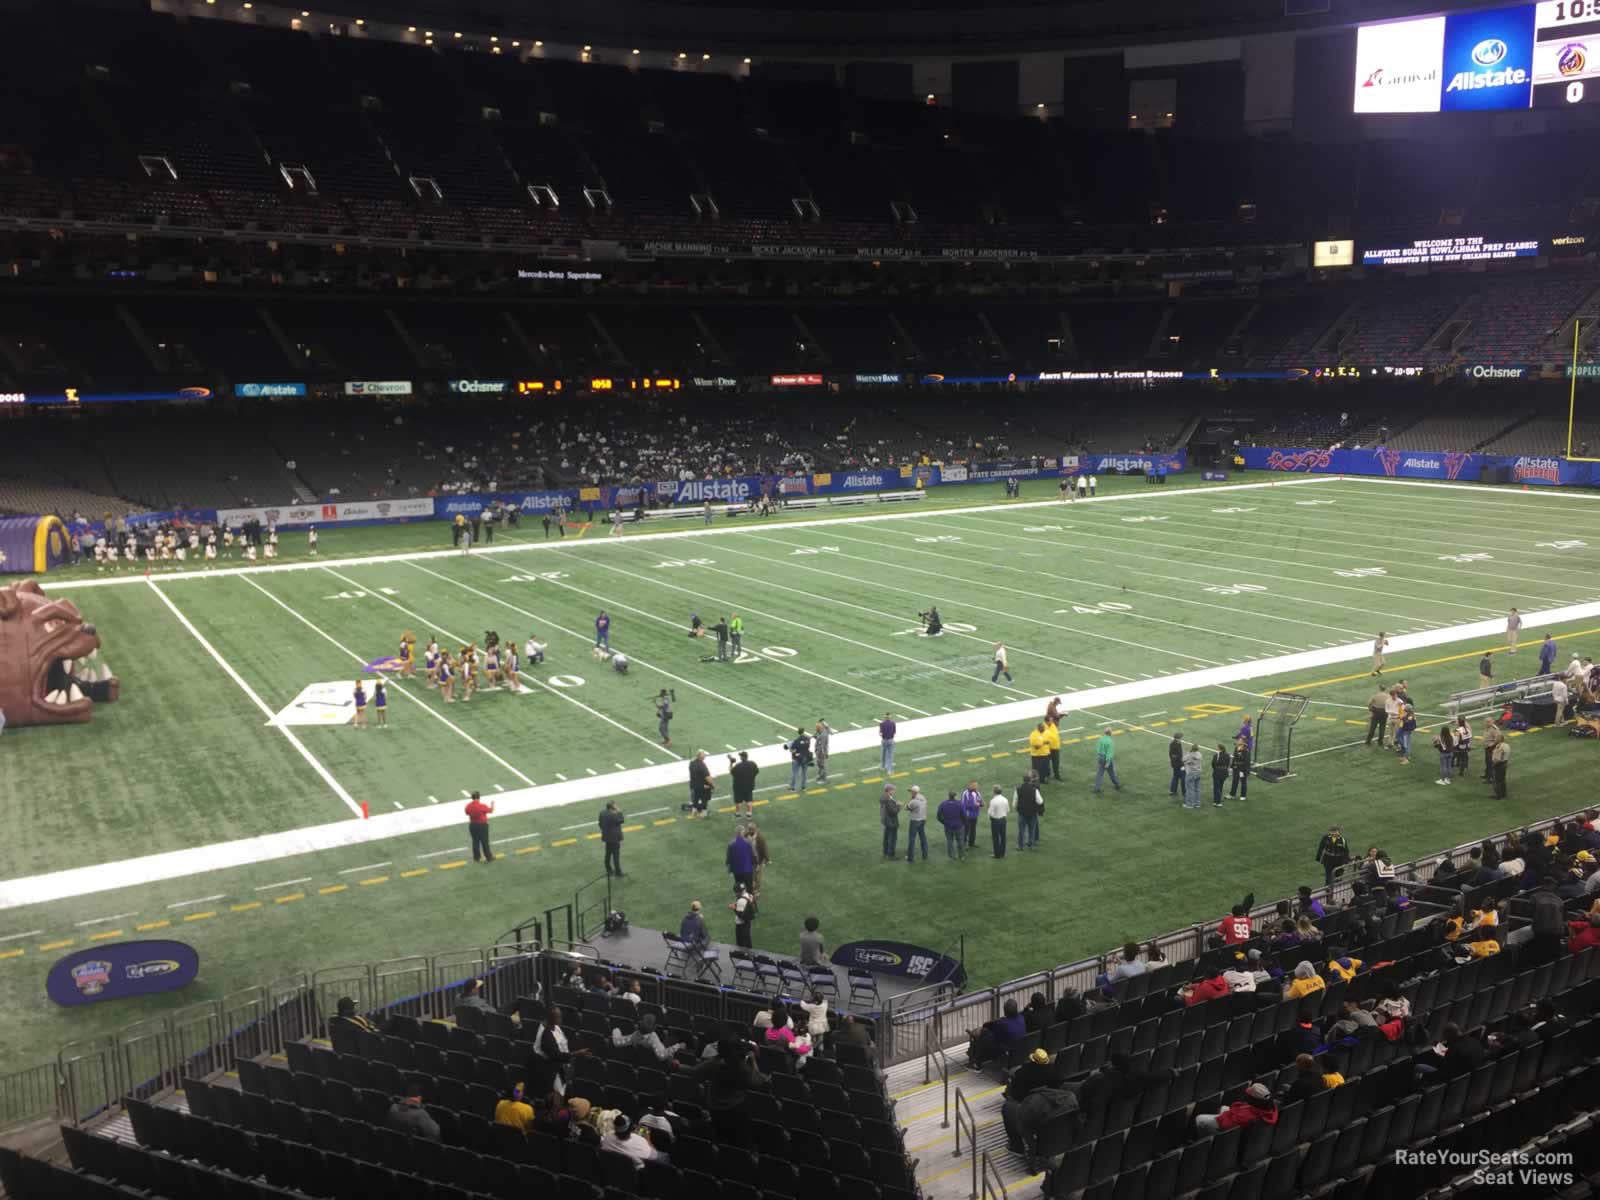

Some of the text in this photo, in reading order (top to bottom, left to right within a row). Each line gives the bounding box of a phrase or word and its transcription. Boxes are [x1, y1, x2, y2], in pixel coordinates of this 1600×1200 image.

[1378, 70, 1437, 86] Carnival
[1566, 81, 1584, 103] 0
[1414, 239, 1453, 248] WELCOME
[1467, 237, 1483, 245] THE
[1552, 236, 1585, 245] verizon
[1364, 249, 1400, 258] ALLSTATE
[1402, 247, 1428, 256] SUGAR
[1505, 241, 1539, 250] CLASSIC
[1473, 365, 1522, 378] Ochsner
[260, 385, 297, 396] Allstate
[367, 384, 406, 392] Chevron
[459, 380, 504, 392] Ochsner
[1097, 457, 1152, 472] Allstate
[1403, 458, 1440, 468] Allstate
[1514, 456, 1559, 469] Allstate
[843, 474, 882, 487] Allstate
[678, 480, 750, 500] Allstate
[446, 501, 482, 512] Allstate
[521, 495, 571, 510] Allstate
[1233, 923, 1250, 939] 99
